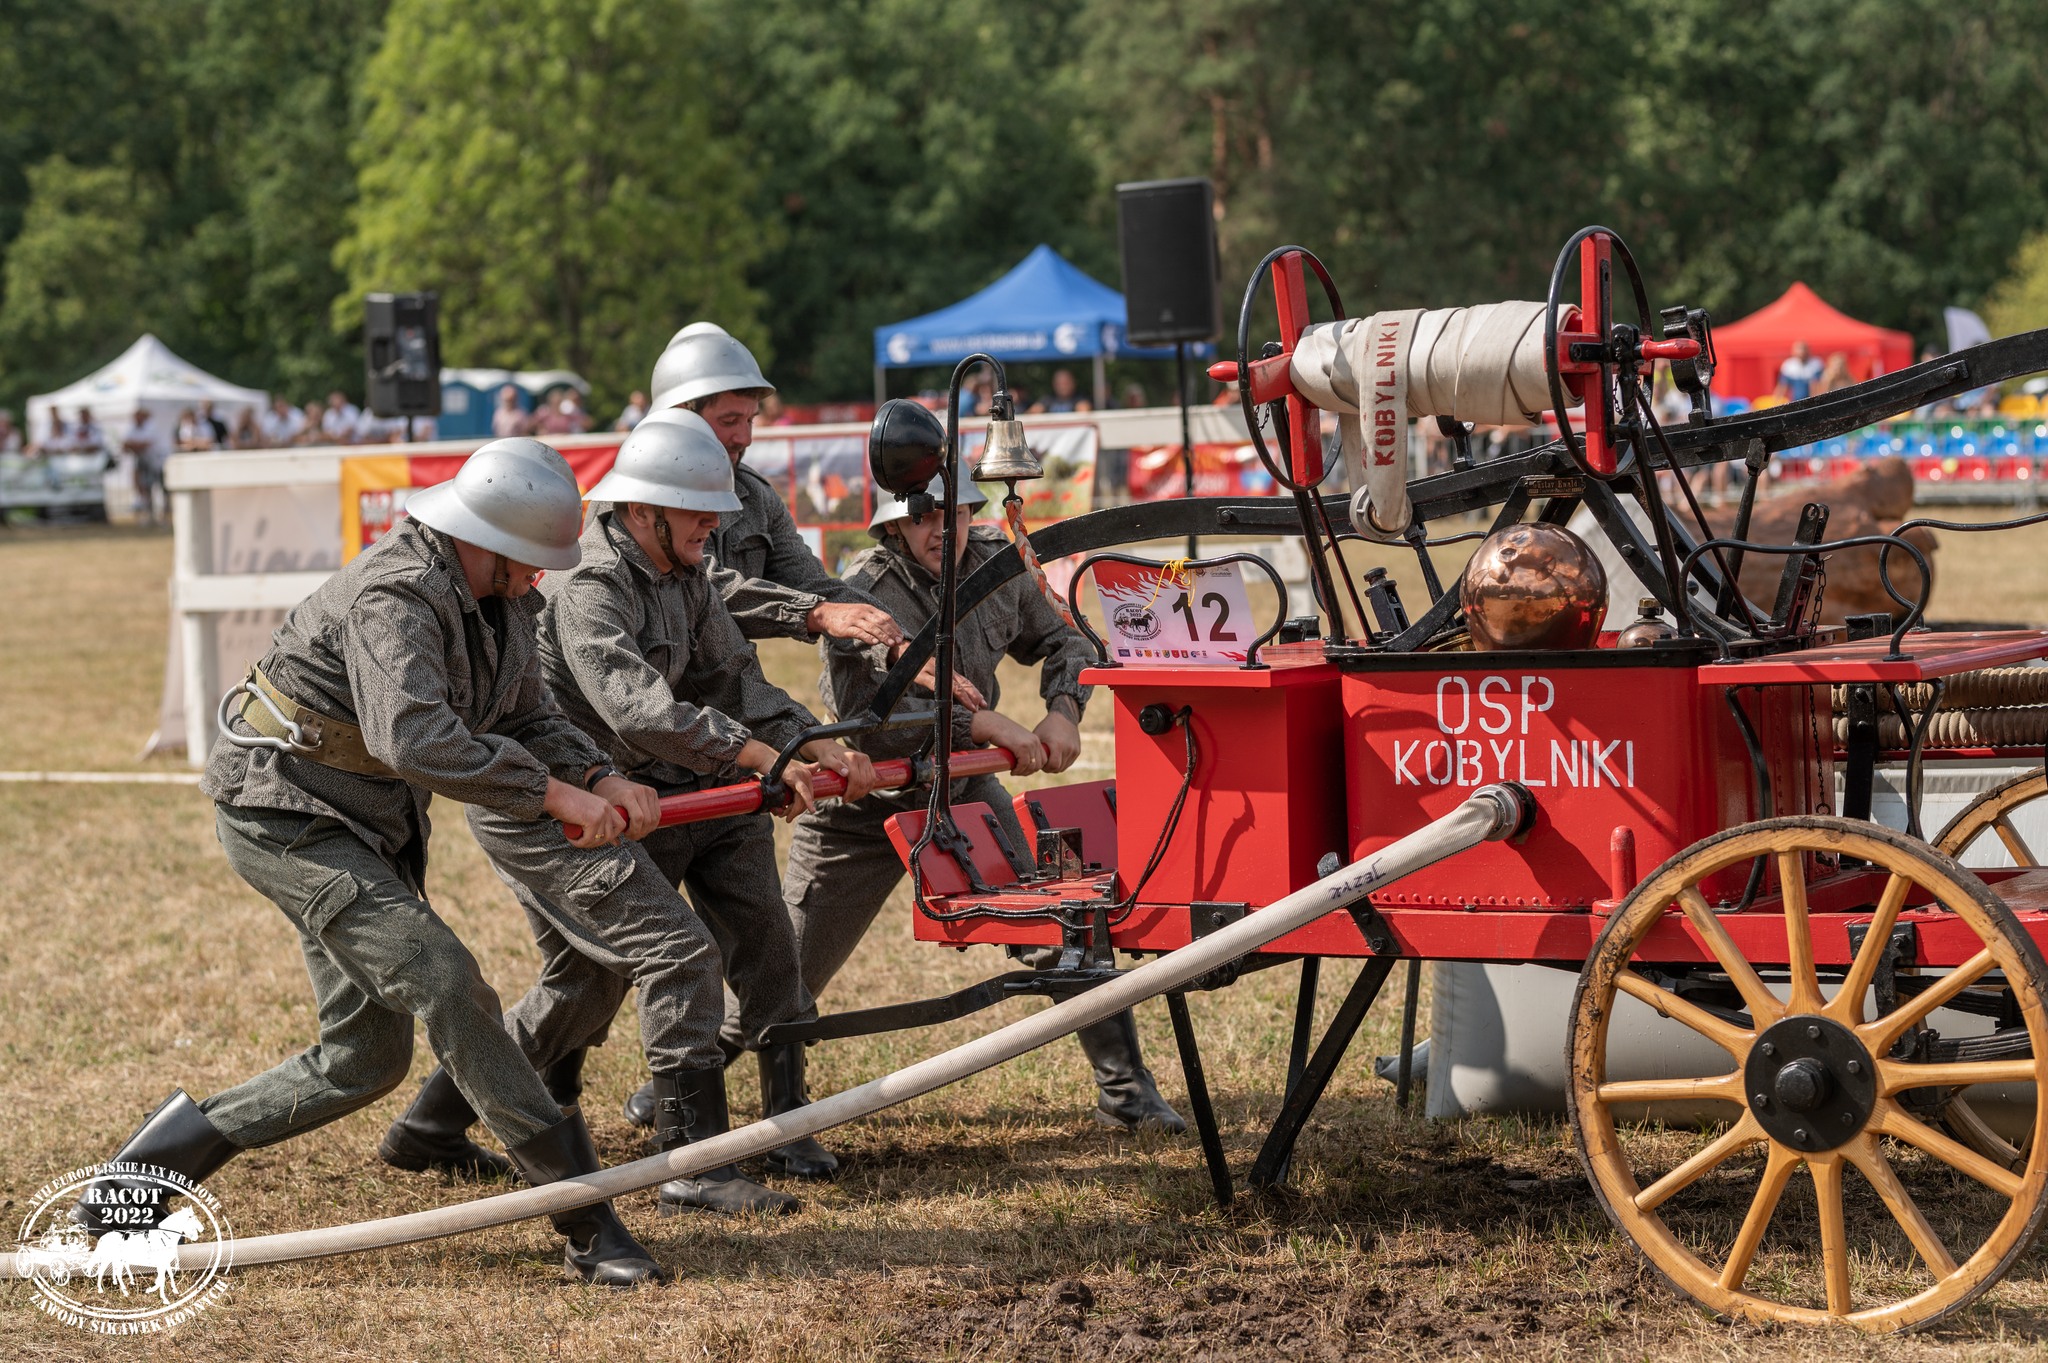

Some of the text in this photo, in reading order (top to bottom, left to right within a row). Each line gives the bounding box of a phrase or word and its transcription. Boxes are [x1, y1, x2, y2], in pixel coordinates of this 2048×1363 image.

[1373, 320, 1400, 467] KOBYLNIKI
[1171, 592, 1238, 642] 12
[1436, 675, 1555, 735] OSP
[1394, 739, 1635, 788] KOBYLNIKI
